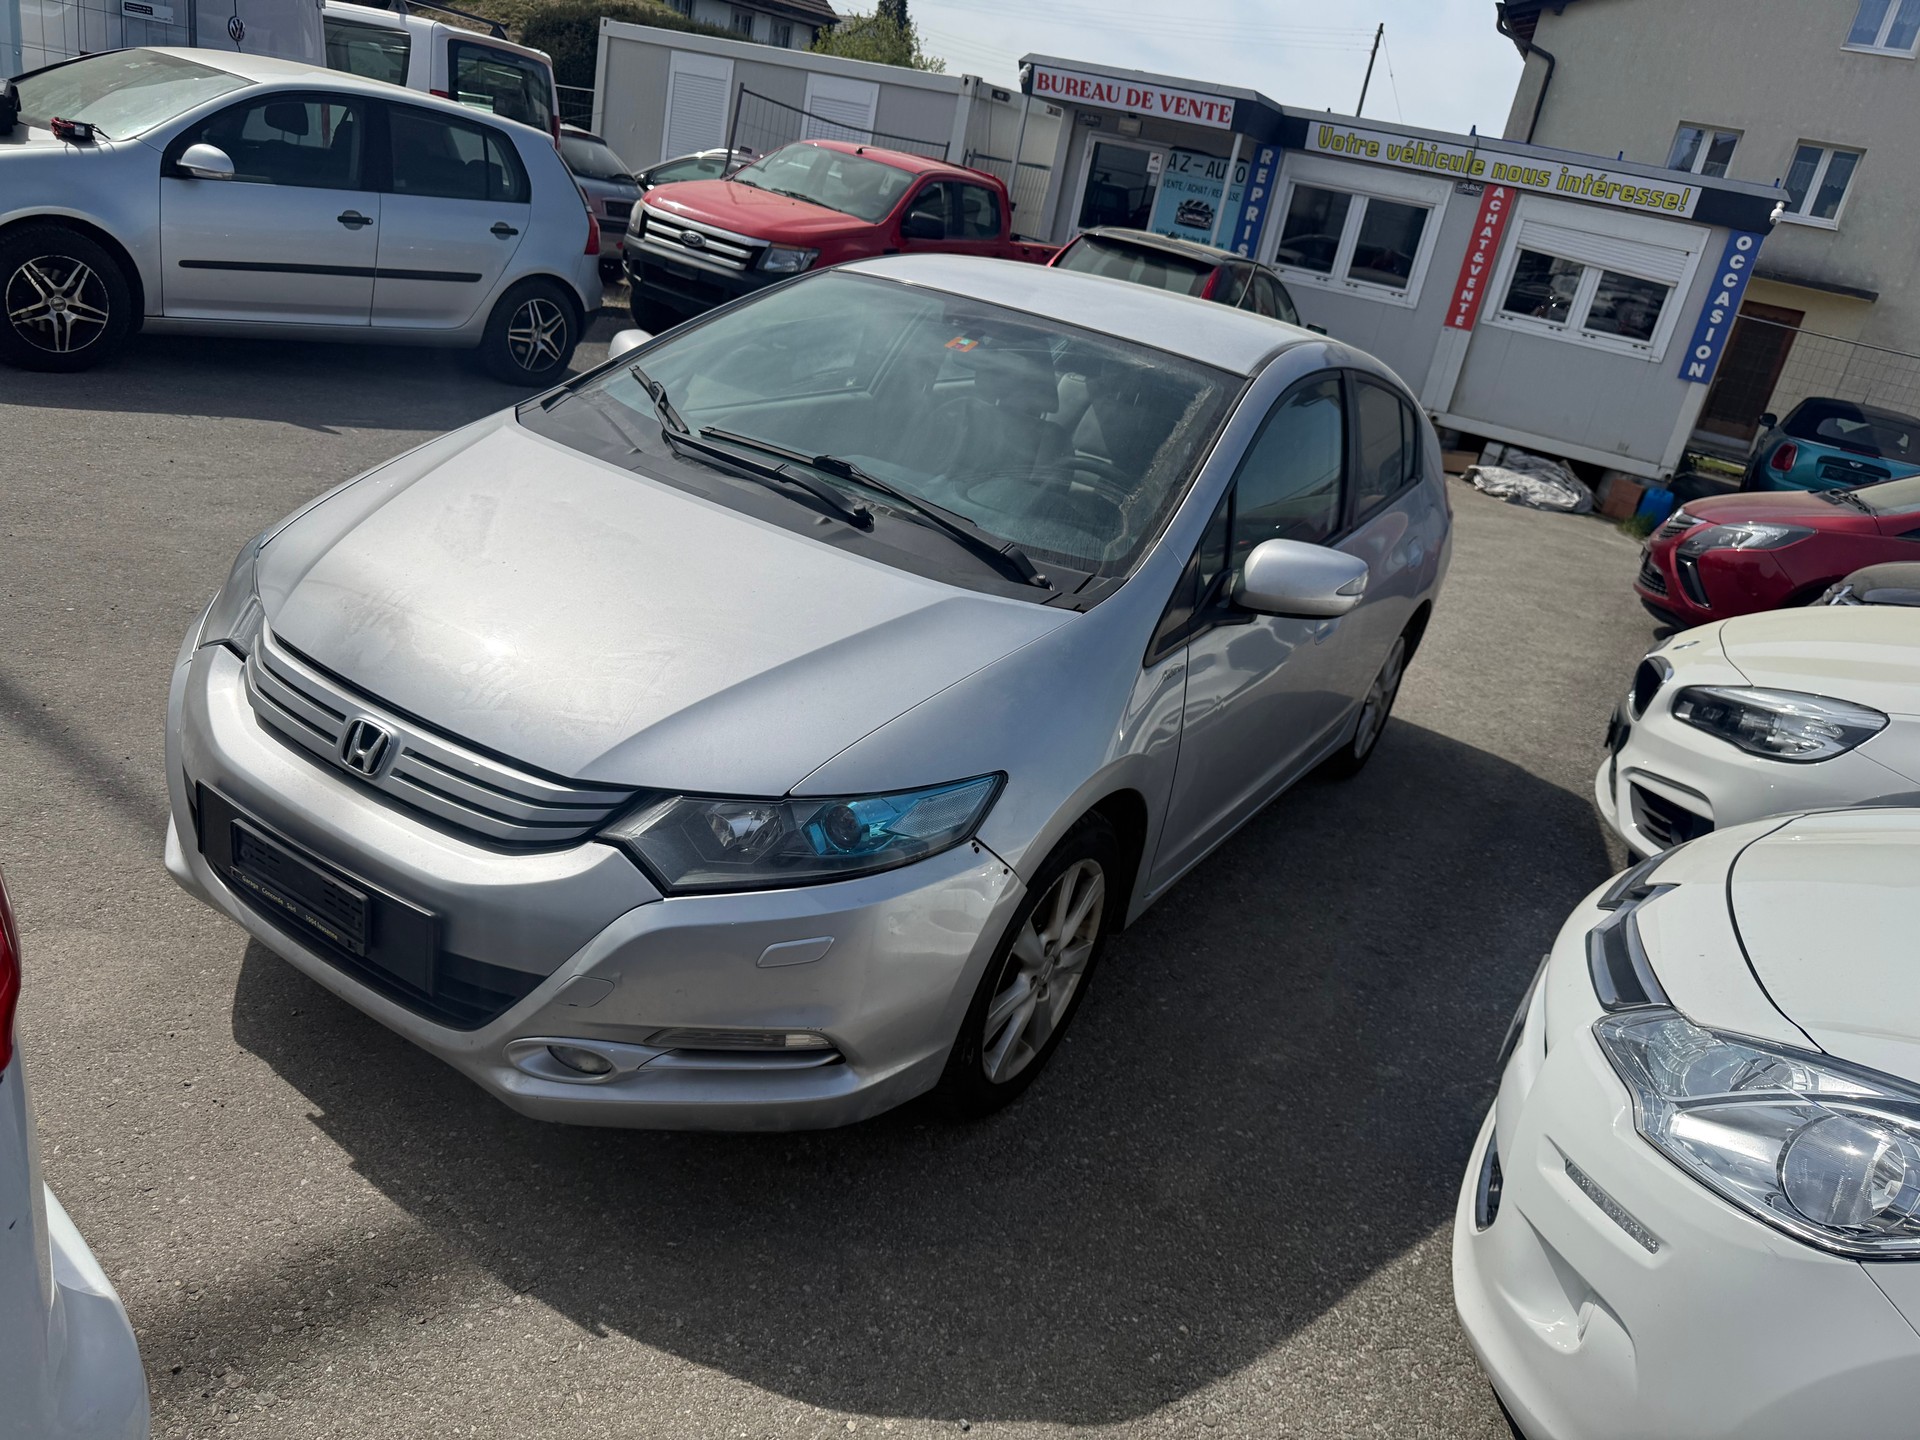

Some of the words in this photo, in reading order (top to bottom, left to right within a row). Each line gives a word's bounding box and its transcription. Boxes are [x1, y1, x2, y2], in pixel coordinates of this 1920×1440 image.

[1036, 72, 1121, 104] BUREAU
[1125, 89, 1153, 109] DE
[1159, 93, 1233, 124] VENTE
[1166, 152, 1246, 184] AZ-AUO
[1236, 148, 1274, 258] REPRIS
[1317, 124, 1380, 158] Votre
[1386, 140, 1486, 176] véhicule
[1490, 161, 1552, 188] nous
[1556, 166, 1692, 213] intéresse!
[1454, 186, 1505, 326] ACHAT&VENTE
[1687, 235, 1753, 379] OCCASION
